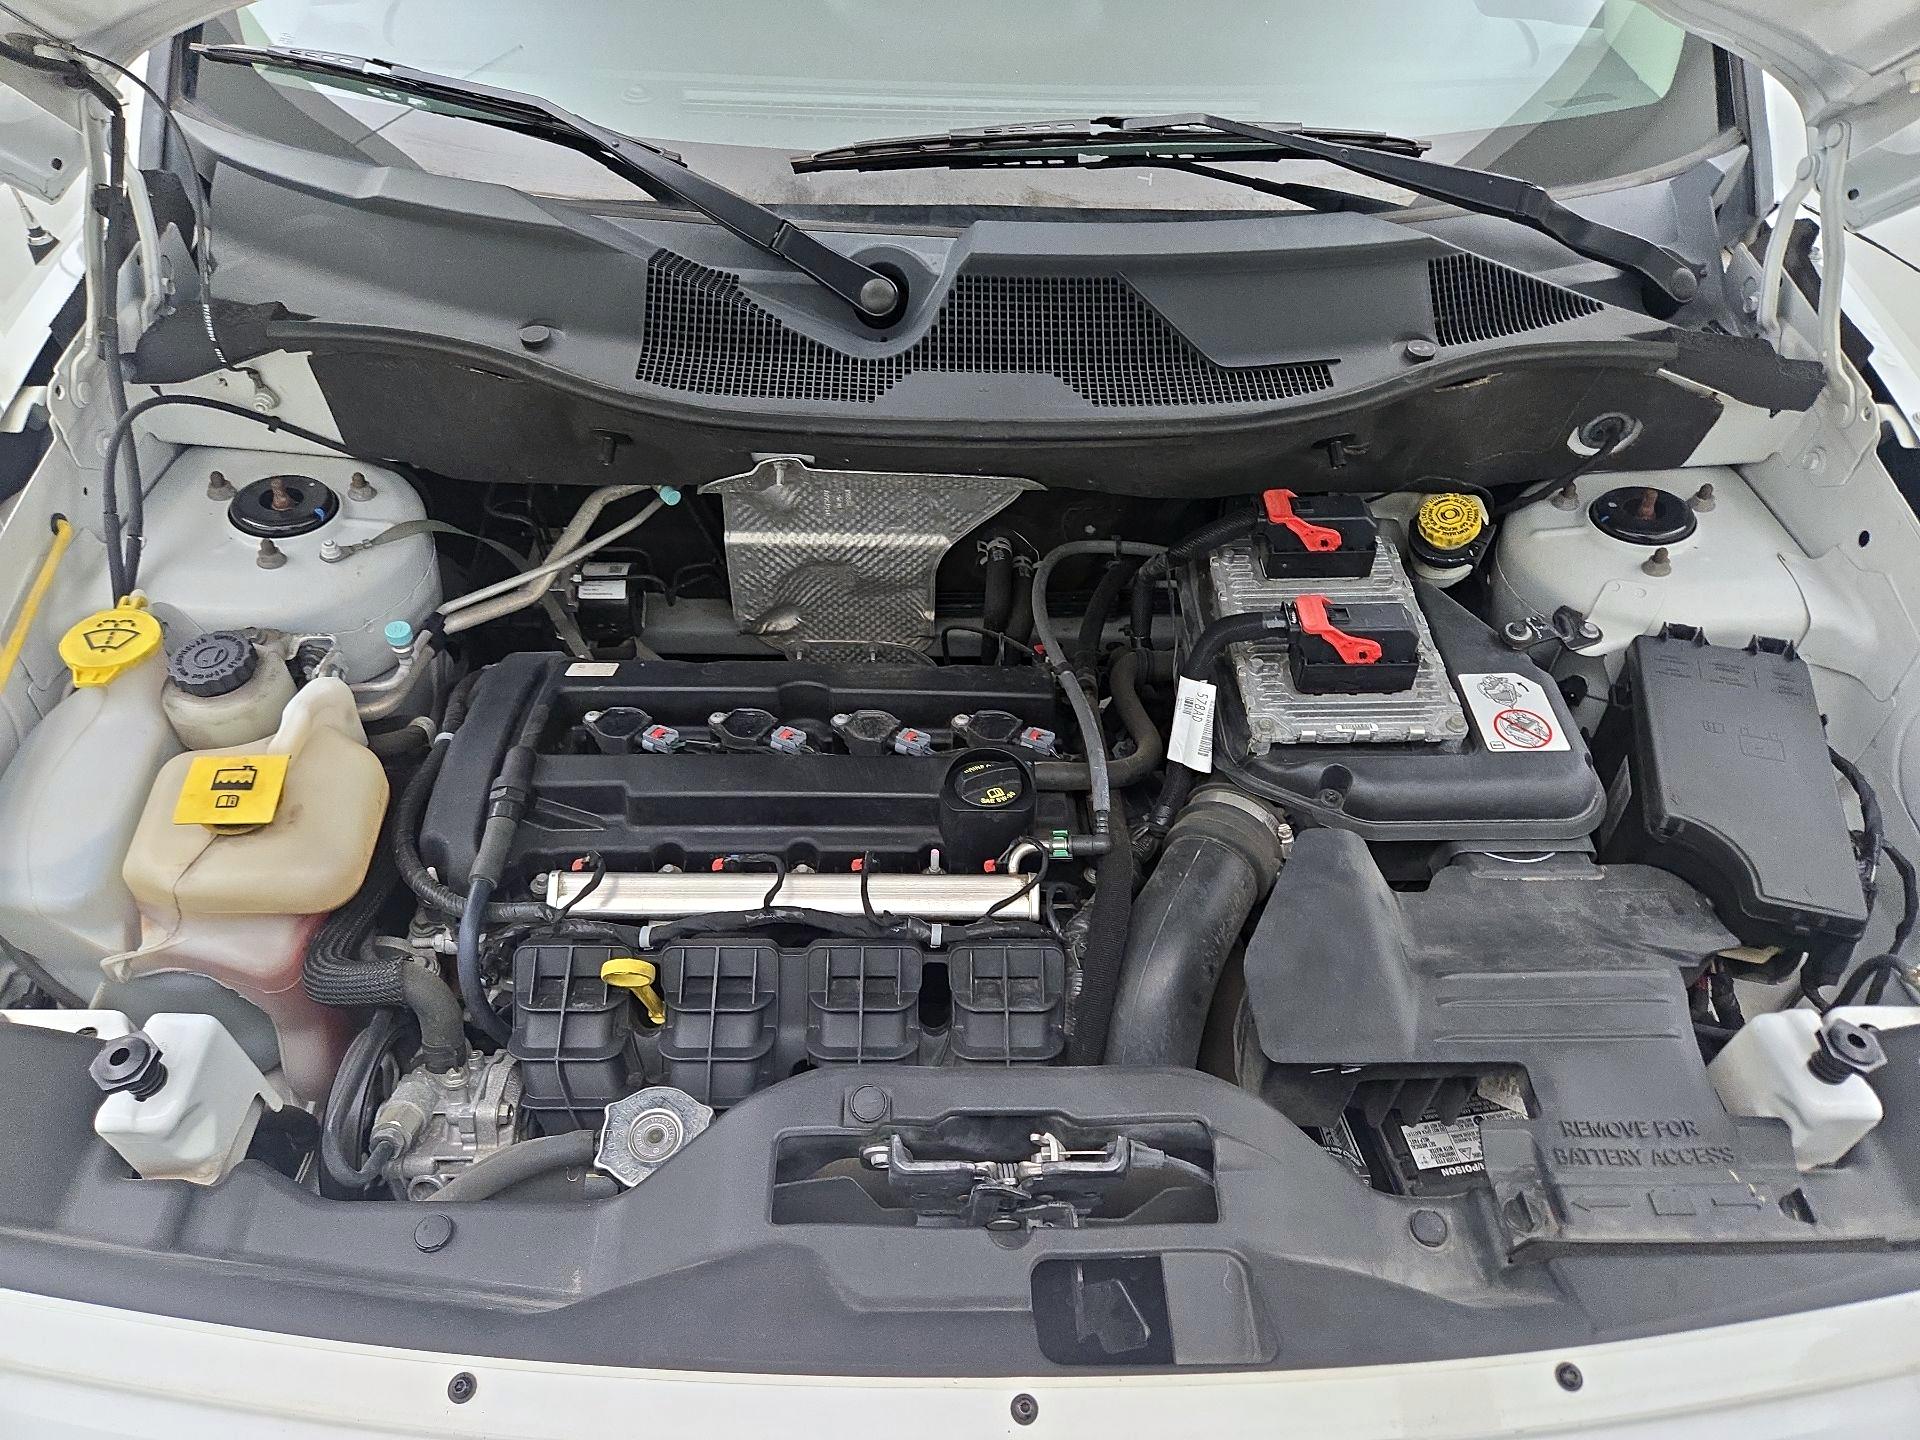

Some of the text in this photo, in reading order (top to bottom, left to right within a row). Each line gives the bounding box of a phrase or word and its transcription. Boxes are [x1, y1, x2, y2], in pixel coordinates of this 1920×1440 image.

[1192, 692, 1208, 722] 578AD
[1559, 1120, 1699, 1138] REMOVE FOR
[1551, 1147, 1734, 1166] BATTERY ACCESS
